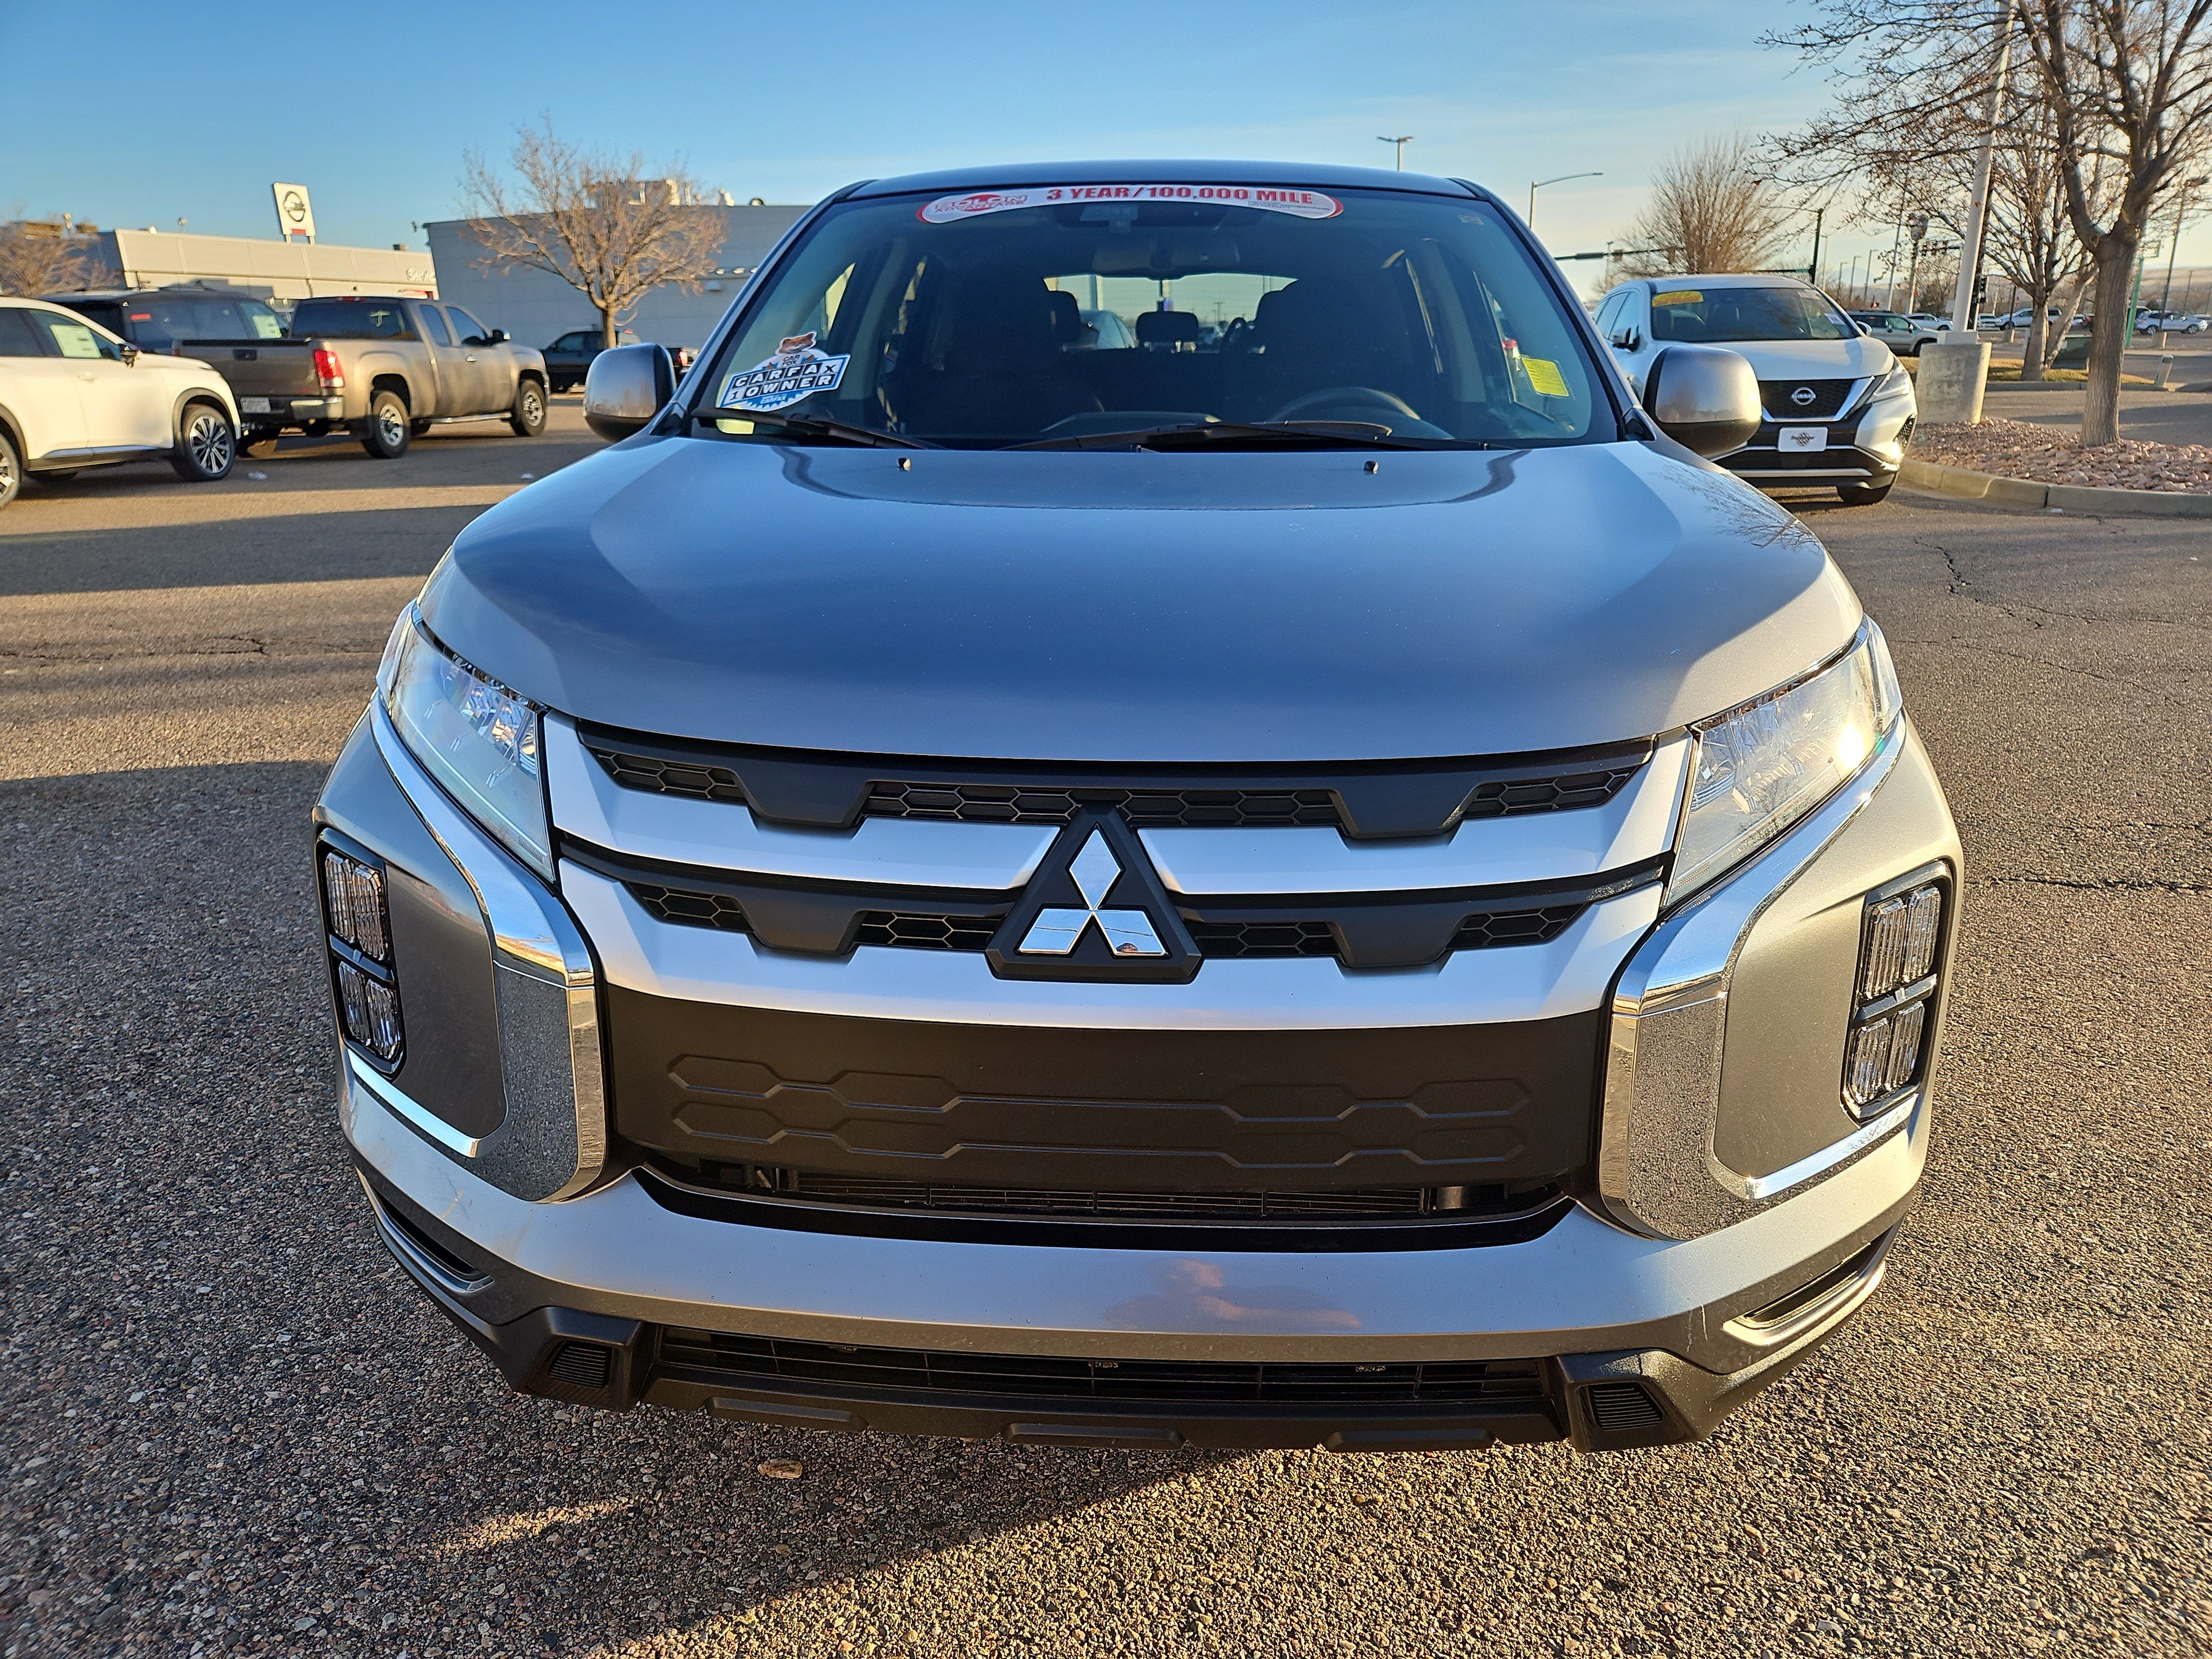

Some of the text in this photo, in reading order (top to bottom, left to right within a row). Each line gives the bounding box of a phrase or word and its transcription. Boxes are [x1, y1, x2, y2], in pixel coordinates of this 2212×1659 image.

[1046, 189, 1063, 201] 3
[1256, 190, 1313, 204] MILE
[734, 364, 837, 387] CARFAX
[729, 376, 831, 400] 1 OWNER
